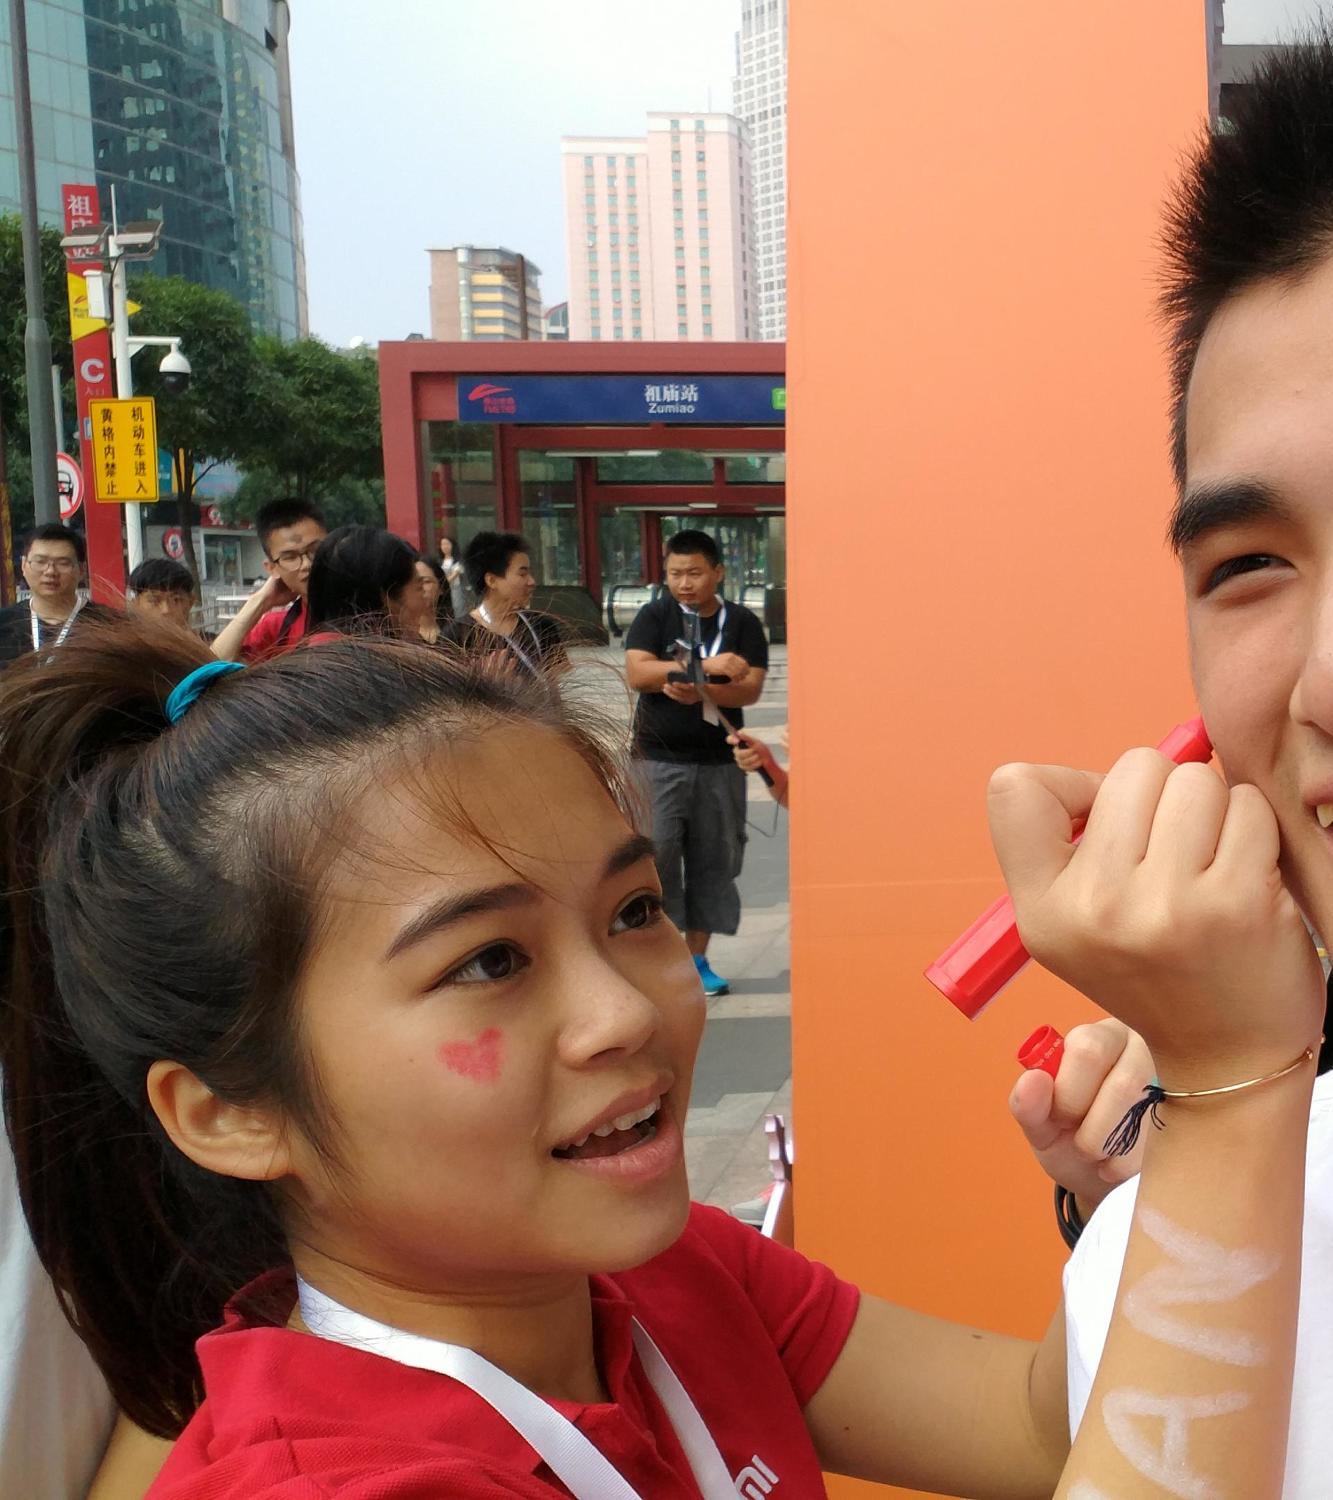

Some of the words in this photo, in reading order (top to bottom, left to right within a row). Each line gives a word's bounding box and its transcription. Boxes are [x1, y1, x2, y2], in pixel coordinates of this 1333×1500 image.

[80, 358, 105, 384] C
[645, 384, 699, 402] 祖庙站
[648, 402, 696, 414] Zumiao
[101, 408, 118, 496] 黄格内禁止
[131, 406, 147, 494] 机动车进入
